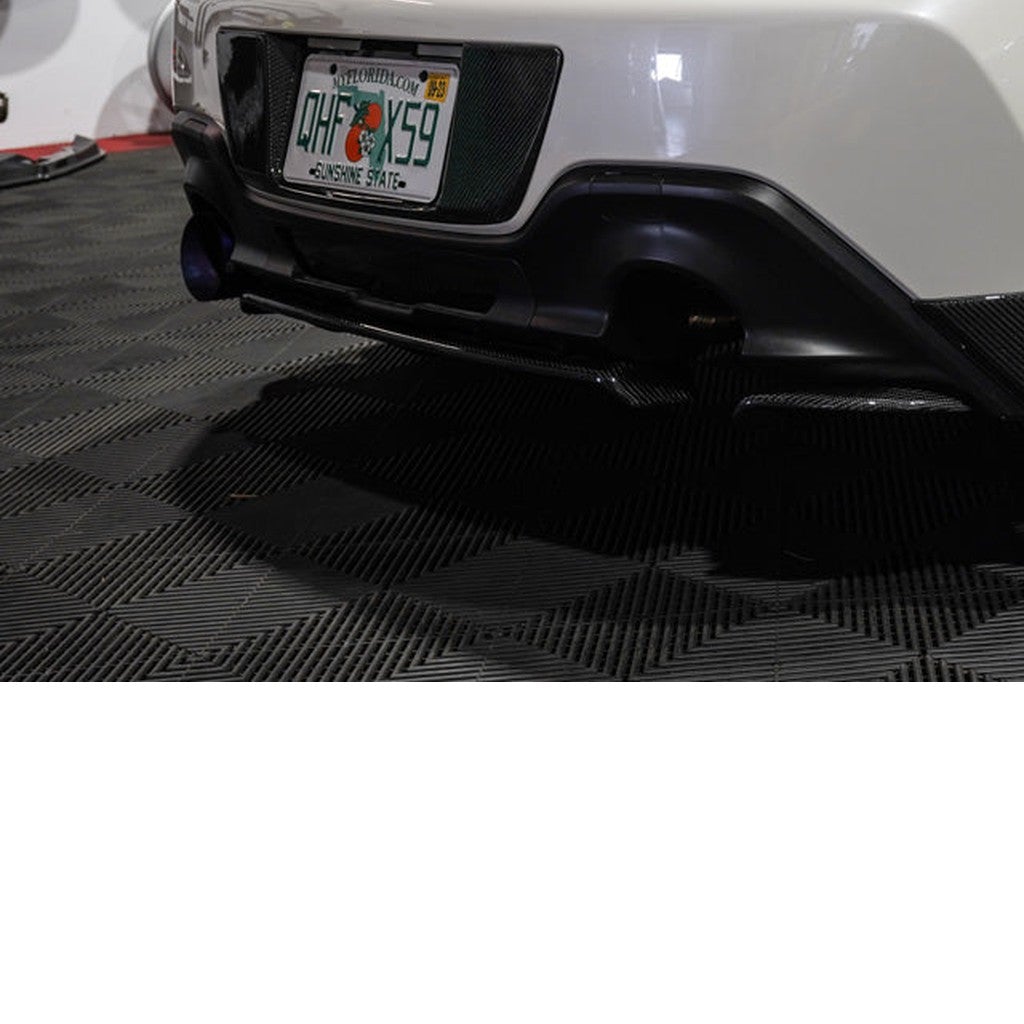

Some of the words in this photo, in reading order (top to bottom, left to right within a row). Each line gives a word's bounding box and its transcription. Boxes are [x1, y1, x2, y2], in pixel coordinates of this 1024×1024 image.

[296, 89, 353, 156] QHF
[376, 98, 441, 168] X59
[315, 161, 364, 186] SUNSHINE
[366, 170, 400, 191] STATE
